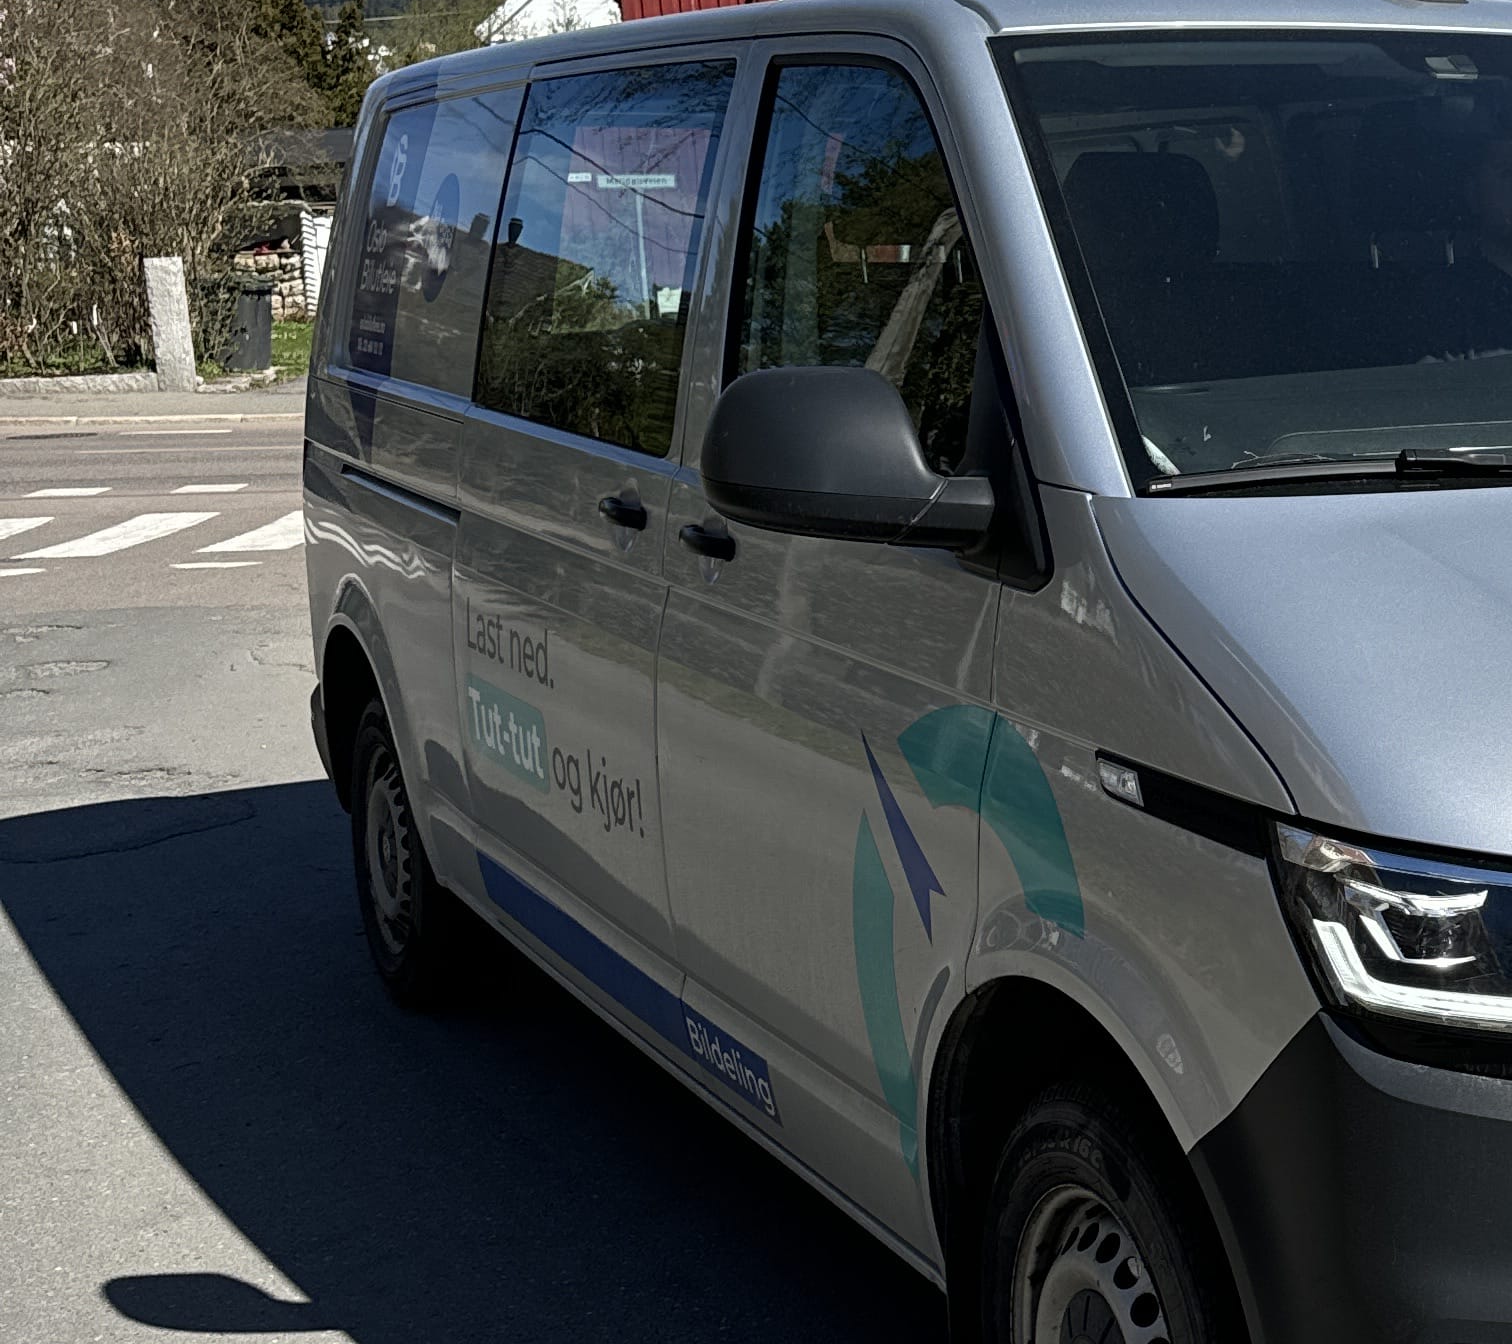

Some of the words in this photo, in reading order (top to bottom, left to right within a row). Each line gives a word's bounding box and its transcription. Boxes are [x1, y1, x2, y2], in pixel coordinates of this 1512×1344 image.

[466, 596, 504, 664] Last
[509, 628, 554, 689] ned.
[468, 685, 545, 780] Tut-tut
[552, 746, 583, 814] og
[586, 748, 645, 839] kjør!
[685, 1016, 776, 1117] Bildeling
